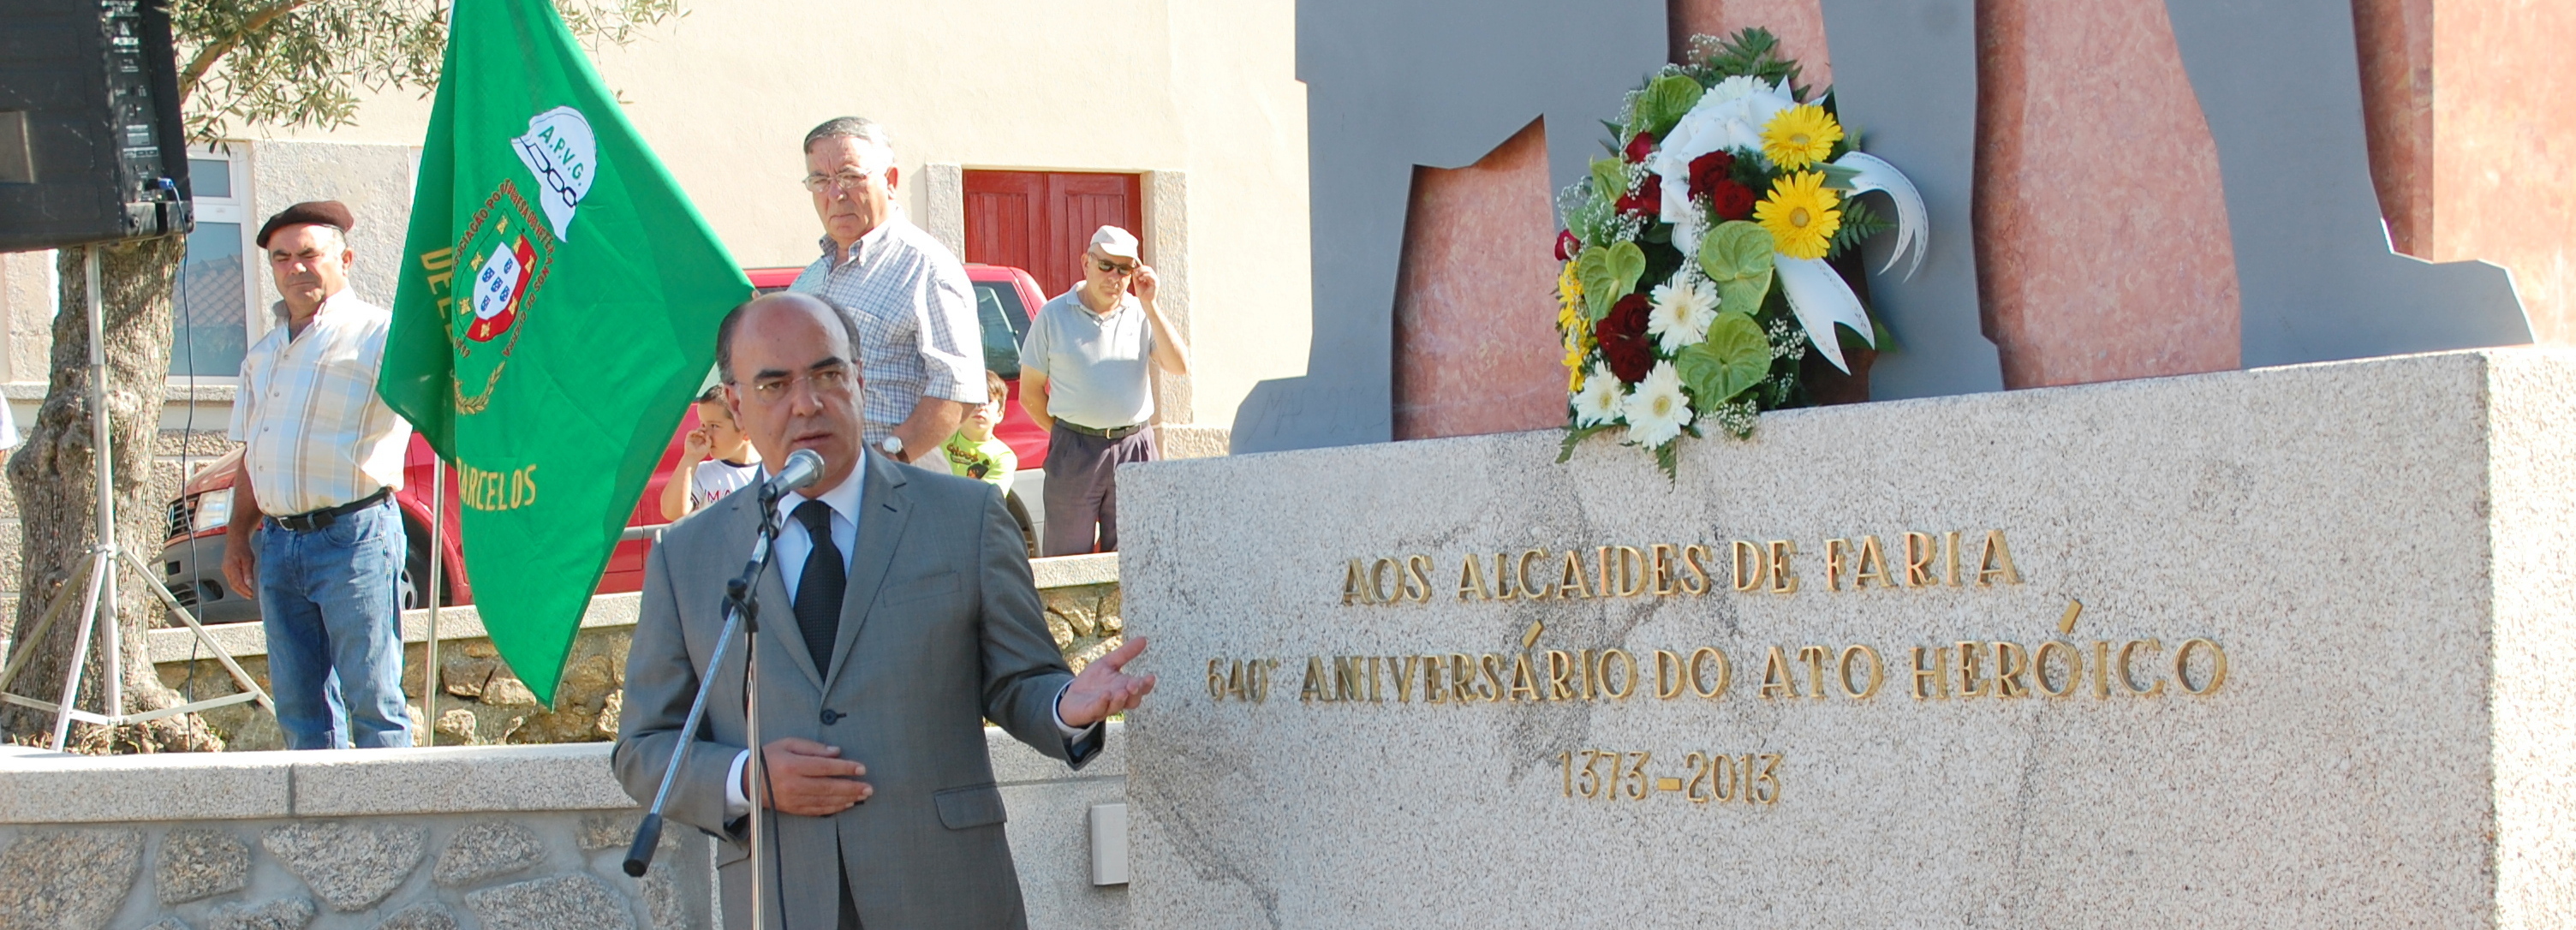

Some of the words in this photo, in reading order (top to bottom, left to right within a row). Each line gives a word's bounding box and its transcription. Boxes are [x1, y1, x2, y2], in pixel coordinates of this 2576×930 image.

[538, 125, 582, 187] A.P.V.G.
[1342, 553, 1434, 606] AOS
[1458, 544, 1714, 602] ALCAIDES
[1732, 539, 1799, 594] DE
[1826, 528, 2024, 592] FARIA
[1300, 619, 1638, 705] ANIVERSÁRIO
[1655, 646, 1732, 700] DO
[1758, 643, 1885, 700] ATO
[1911, 599, 2228, 700] HERÓICO
